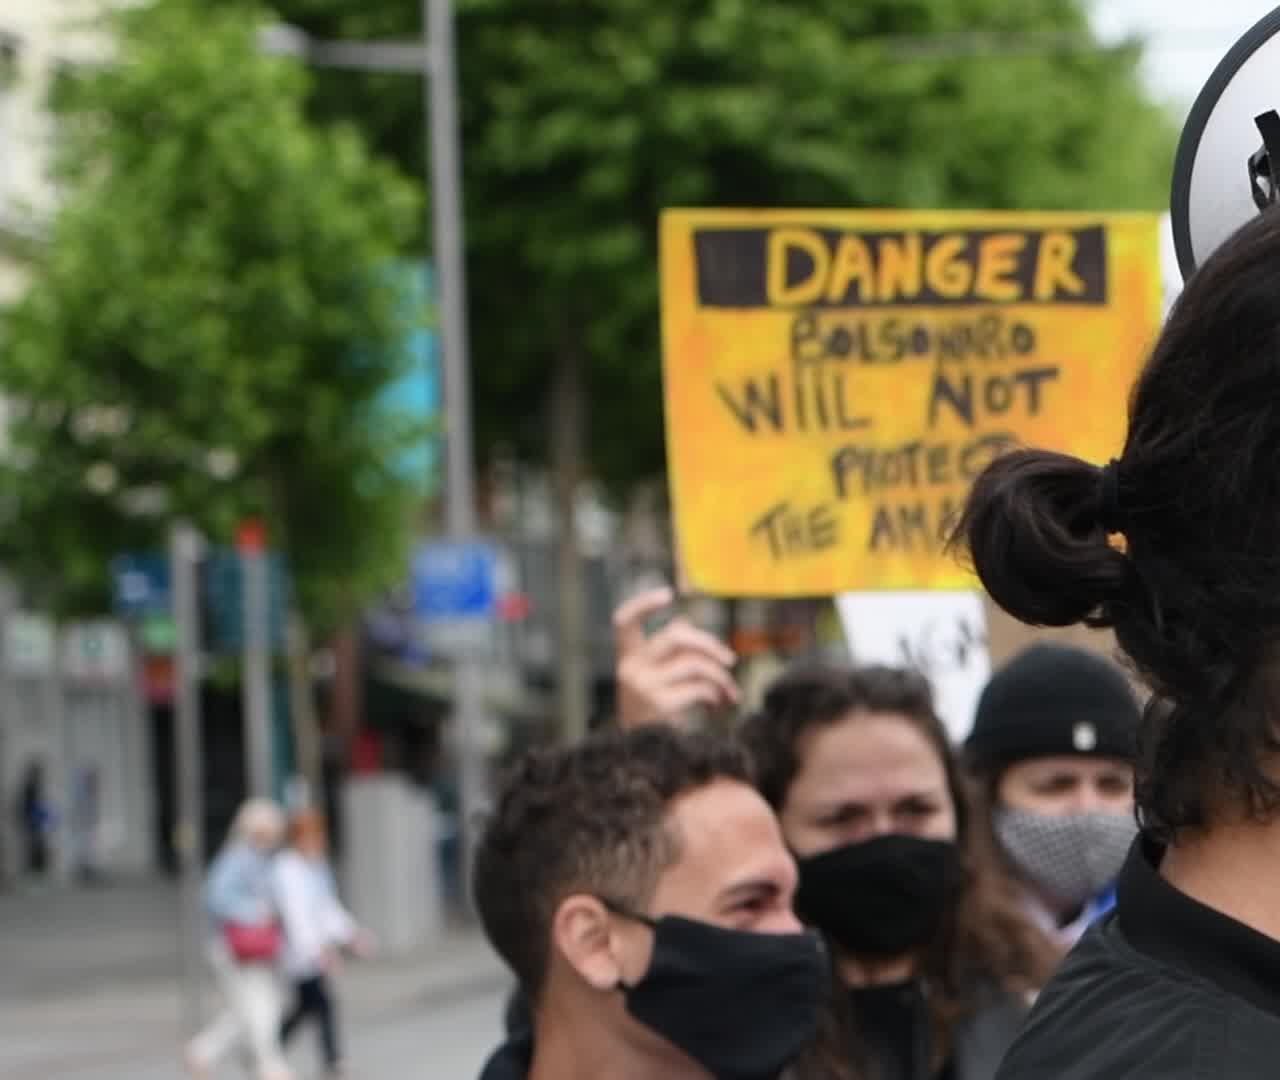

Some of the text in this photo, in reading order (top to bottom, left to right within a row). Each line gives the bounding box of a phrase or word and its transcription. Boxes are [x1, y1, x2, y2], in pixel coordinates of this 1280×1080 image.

[767, 226, 1087, 306] DANGER
[790, 310, 1037, 363] BOLSONARO
[928, 365, 1061, 428] NOT
[748, 500, 840, 562] THE
